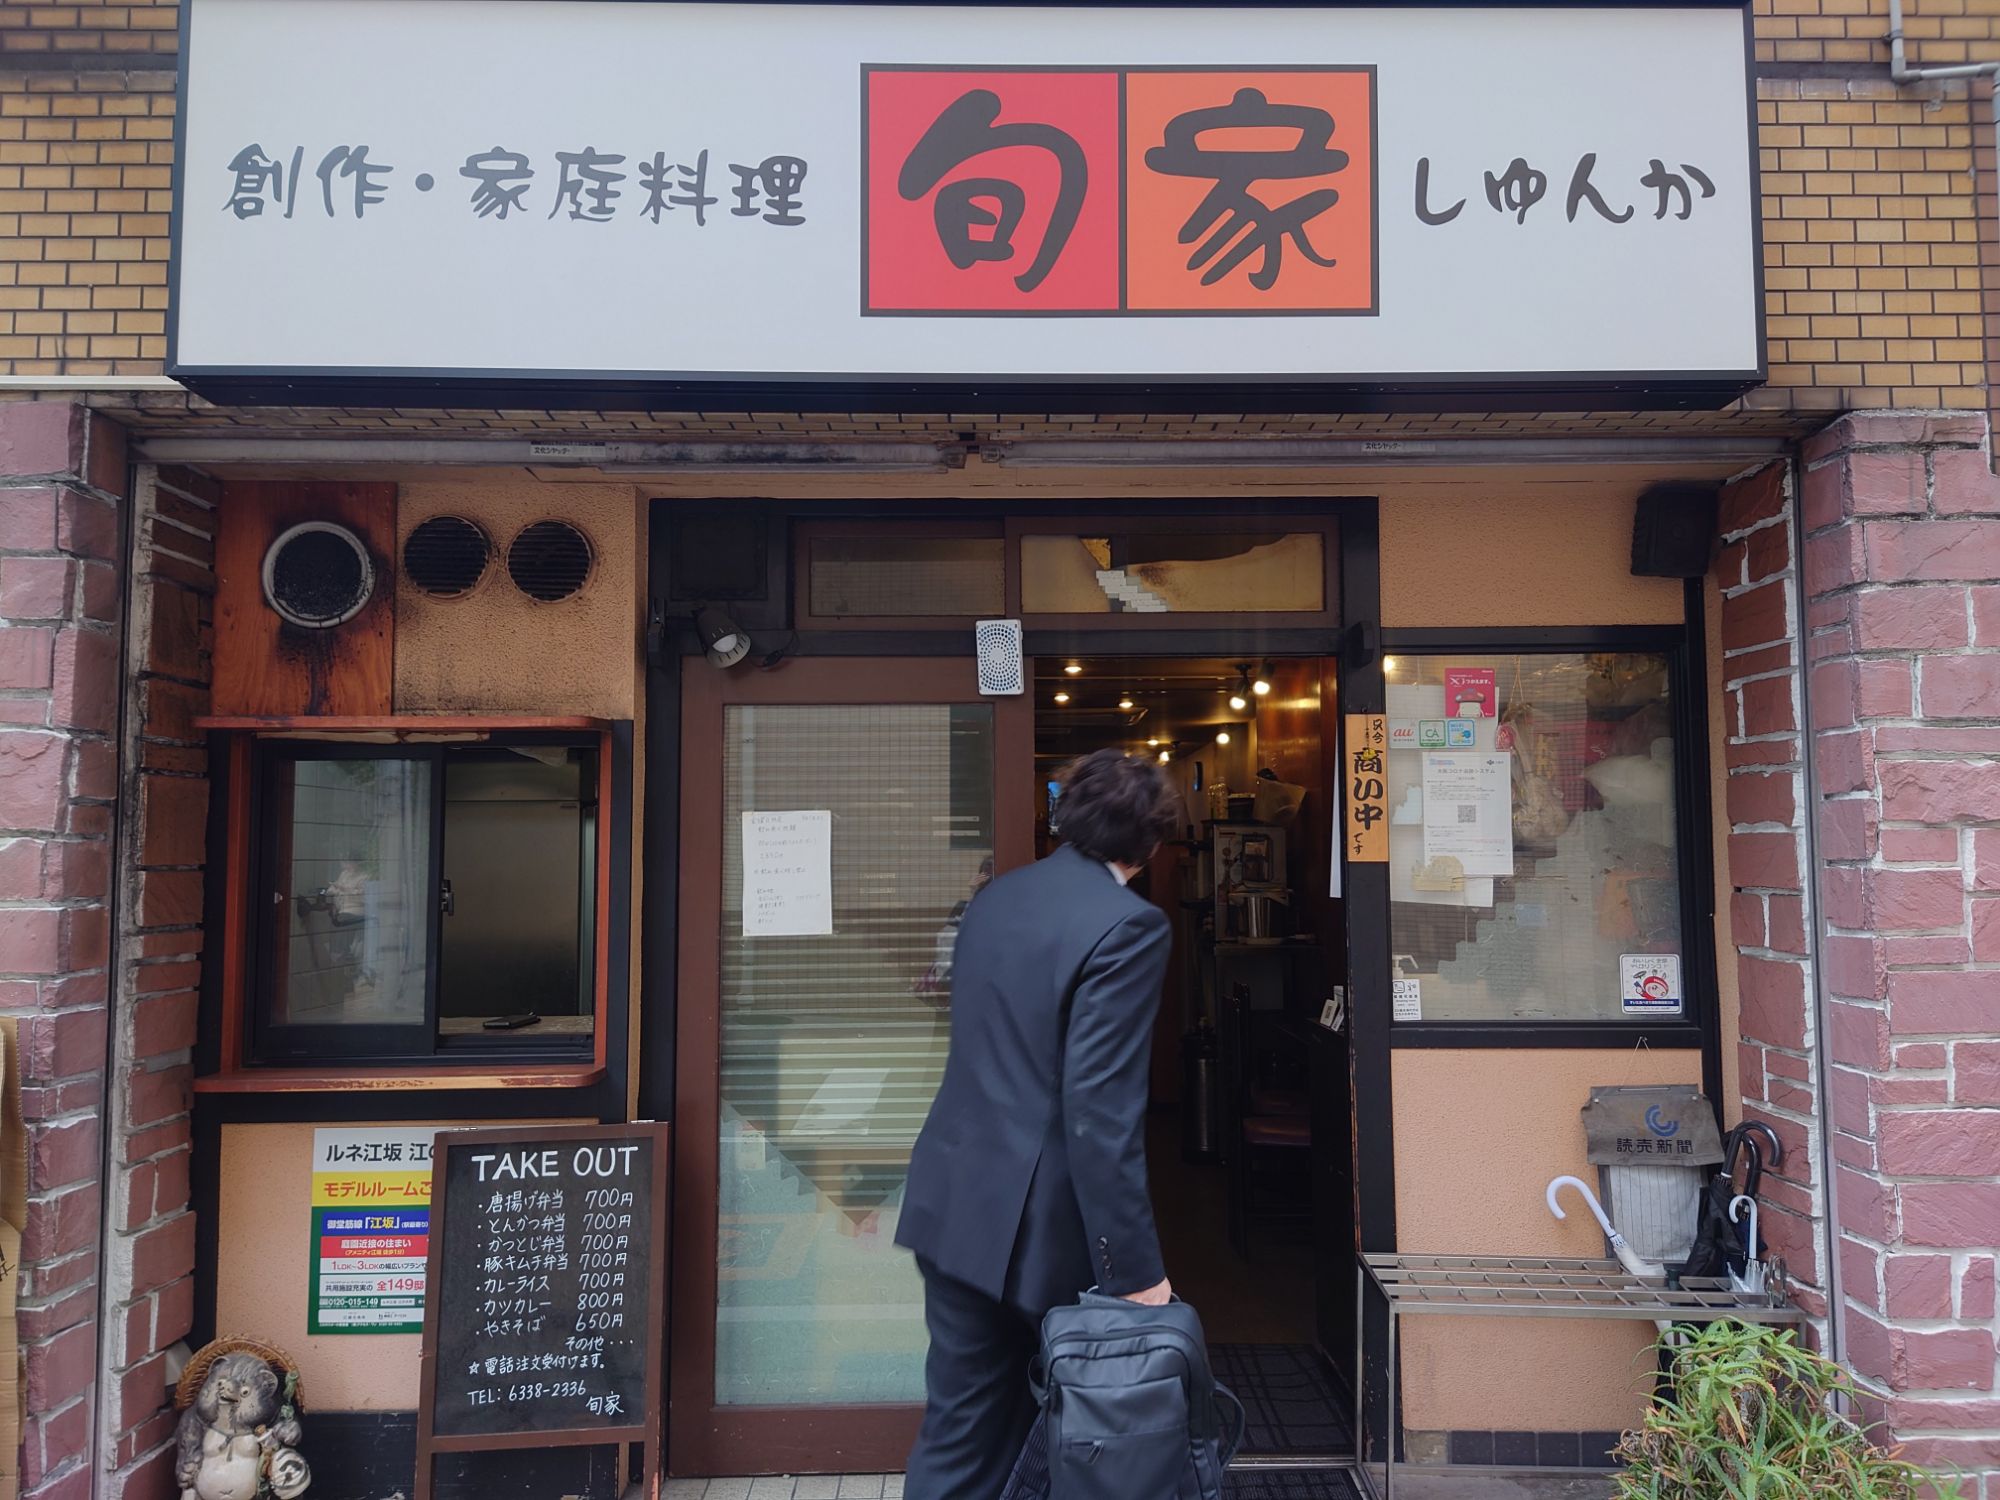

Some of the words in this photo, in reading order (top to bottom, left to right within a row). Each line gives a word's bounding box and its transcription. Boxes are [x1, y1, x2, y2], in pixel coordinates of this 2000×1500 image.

[221, 142, 808, 227] 創作・家庭料理
[897, 87, 1349, 293] 旬家
[1393, 728, 1414, 737] au
[1352, 747, 1384, 831] 商い中
[326, 1142, 403, 1162] ルネ江坂
[1616, 1137, 1694, 1154] 読売新聞
[471, 1150, 560, 1182] TAKE
[573, 1146, 639, 1177] OUT
[486, 1188, 564, 1214] 唐揚げ弁当
[584, 1187, 633, 1210] 700円
[488, 1213, 566, 1234] とんかつ弁当
[582, 1212, 631, 1232] 700円
[488, 1234, 566, 1253] かつとじ弁当
[580, 1233, 628, 1251] 700円
[483, 1252, 569, 1273] 豚キムチ弁当
[579, 1252, 627, 1270] 700円
[483, 1274, 551, 1294] カレーライス
[578, 1272, 625, 1290] 700円
[483, 1298, 551, 1316] カツカレー
[577, 1292, 624, 1311] 800円
[483, 1314, 547, 1338] やきそば
[575, 1312, 624, 1332] 650円
[508, 1379, 587, 1402] 6338-2336
[585, 1390, 625, 1416] 旬家
